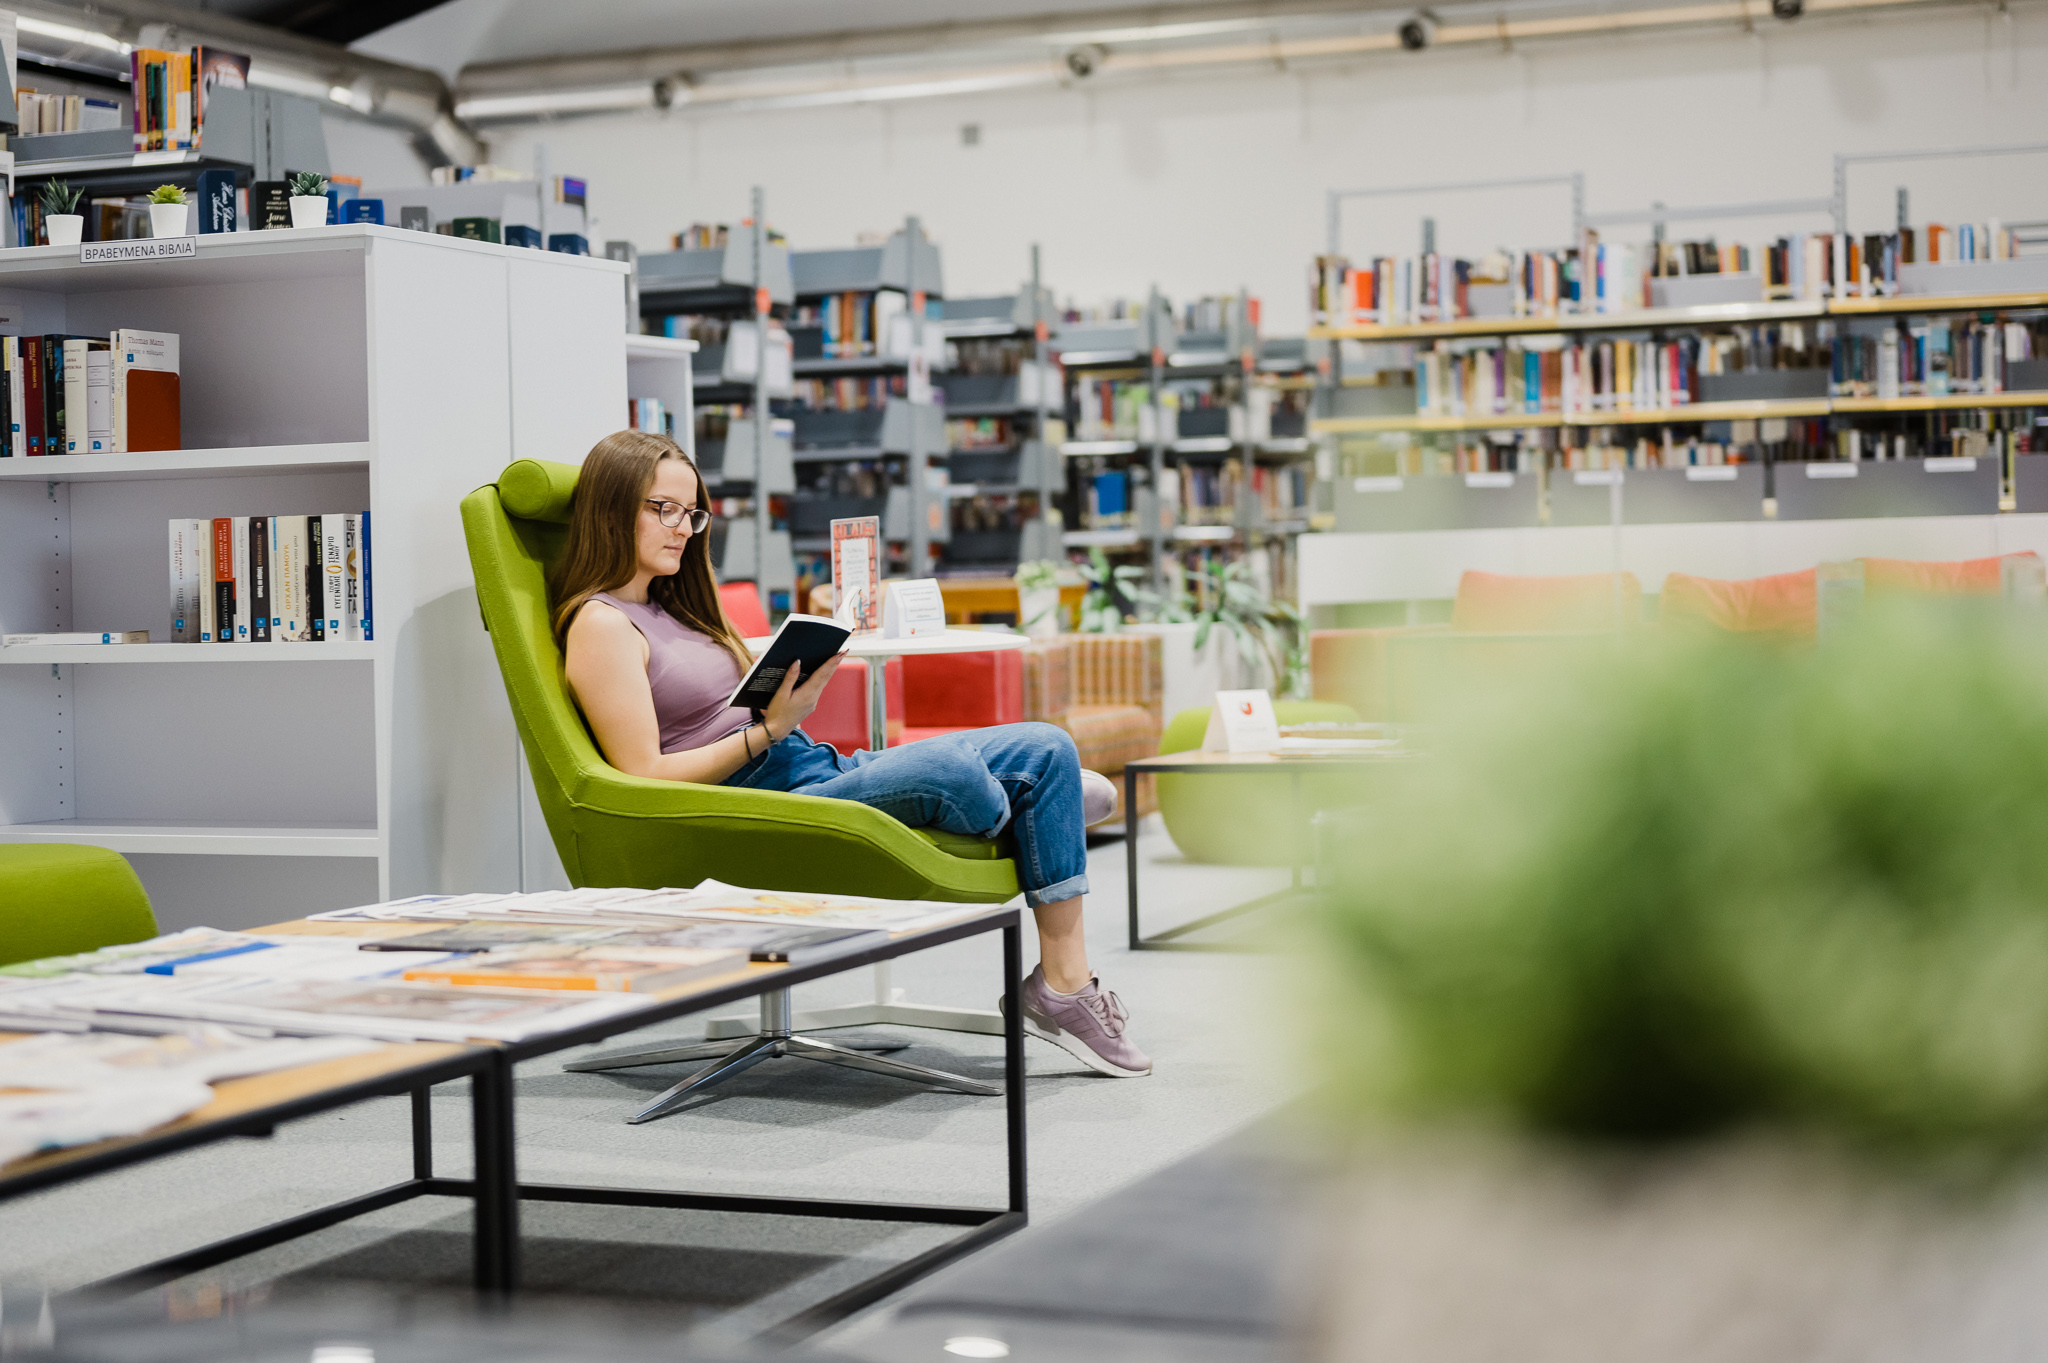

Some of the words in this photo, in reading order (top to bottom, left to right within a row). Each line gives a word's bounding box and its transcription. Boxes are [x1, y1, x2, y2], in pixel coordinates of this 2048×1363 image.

[221, 181, 234, 205] Hans
[266, 212, 286, 223] Jane
[85, 245, 156, 260] ΒΡΑΒΕΥΜΕΝΑ
[158, 242, 192, 256] ΒΙΒΛΙΑ
[127, 336, 149, 345] Thomas
[149, 338, 165, 347] Mann
[328, 536, 336, 563] ΣΕΝΑΡΙΟ
